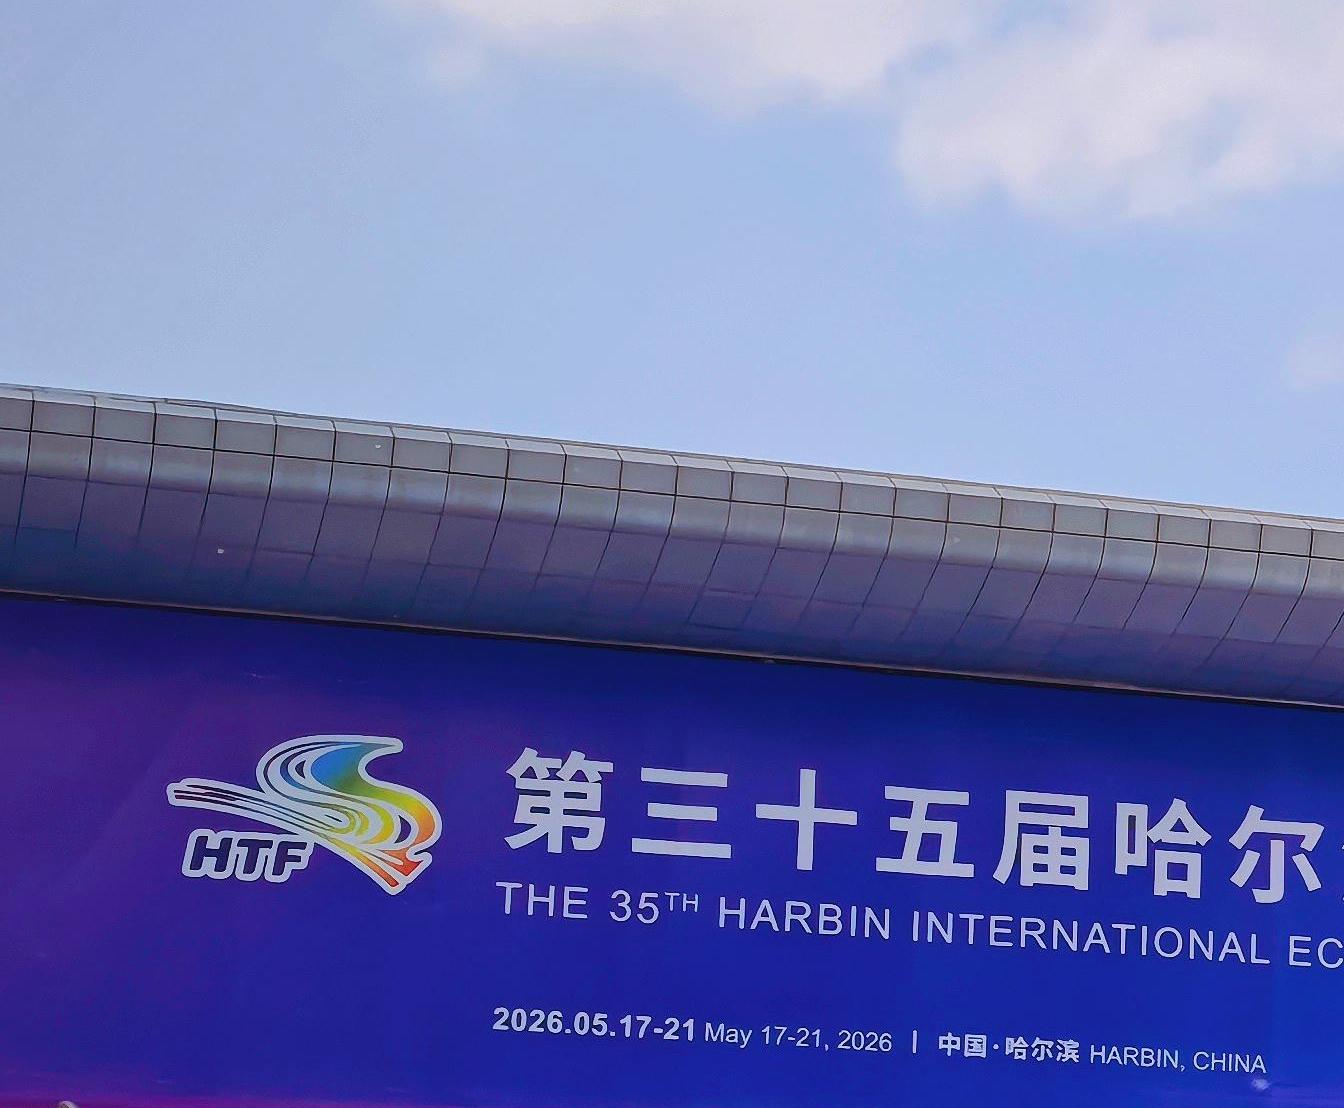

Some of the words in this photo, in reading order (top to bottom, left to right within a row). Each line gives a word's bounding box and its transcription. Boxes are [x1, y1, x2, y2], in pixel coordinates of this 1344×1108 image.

[185, 831, 311, 882] HTF
[496, 881, 590, 920] THE
[609, 890, 700, 925] 35TH
[718, 897, 891, 942] HARBIN
[912, 910, 1271, 967] INTERNATIONAL
[493, 1007, 697, 1043] 2026.05.17-21
[704, 1022, 753, 1050] May
[761, 1025, 830, 1052] 17-21,
[837, 1029, 893, 1053] 2026
[938, 1031, 1081, 1065] 中国·哈尔滨
[1090, 1045, 1186, 1074] HARBIN,
[1193, 1050, 1268, 1075] CHINA
